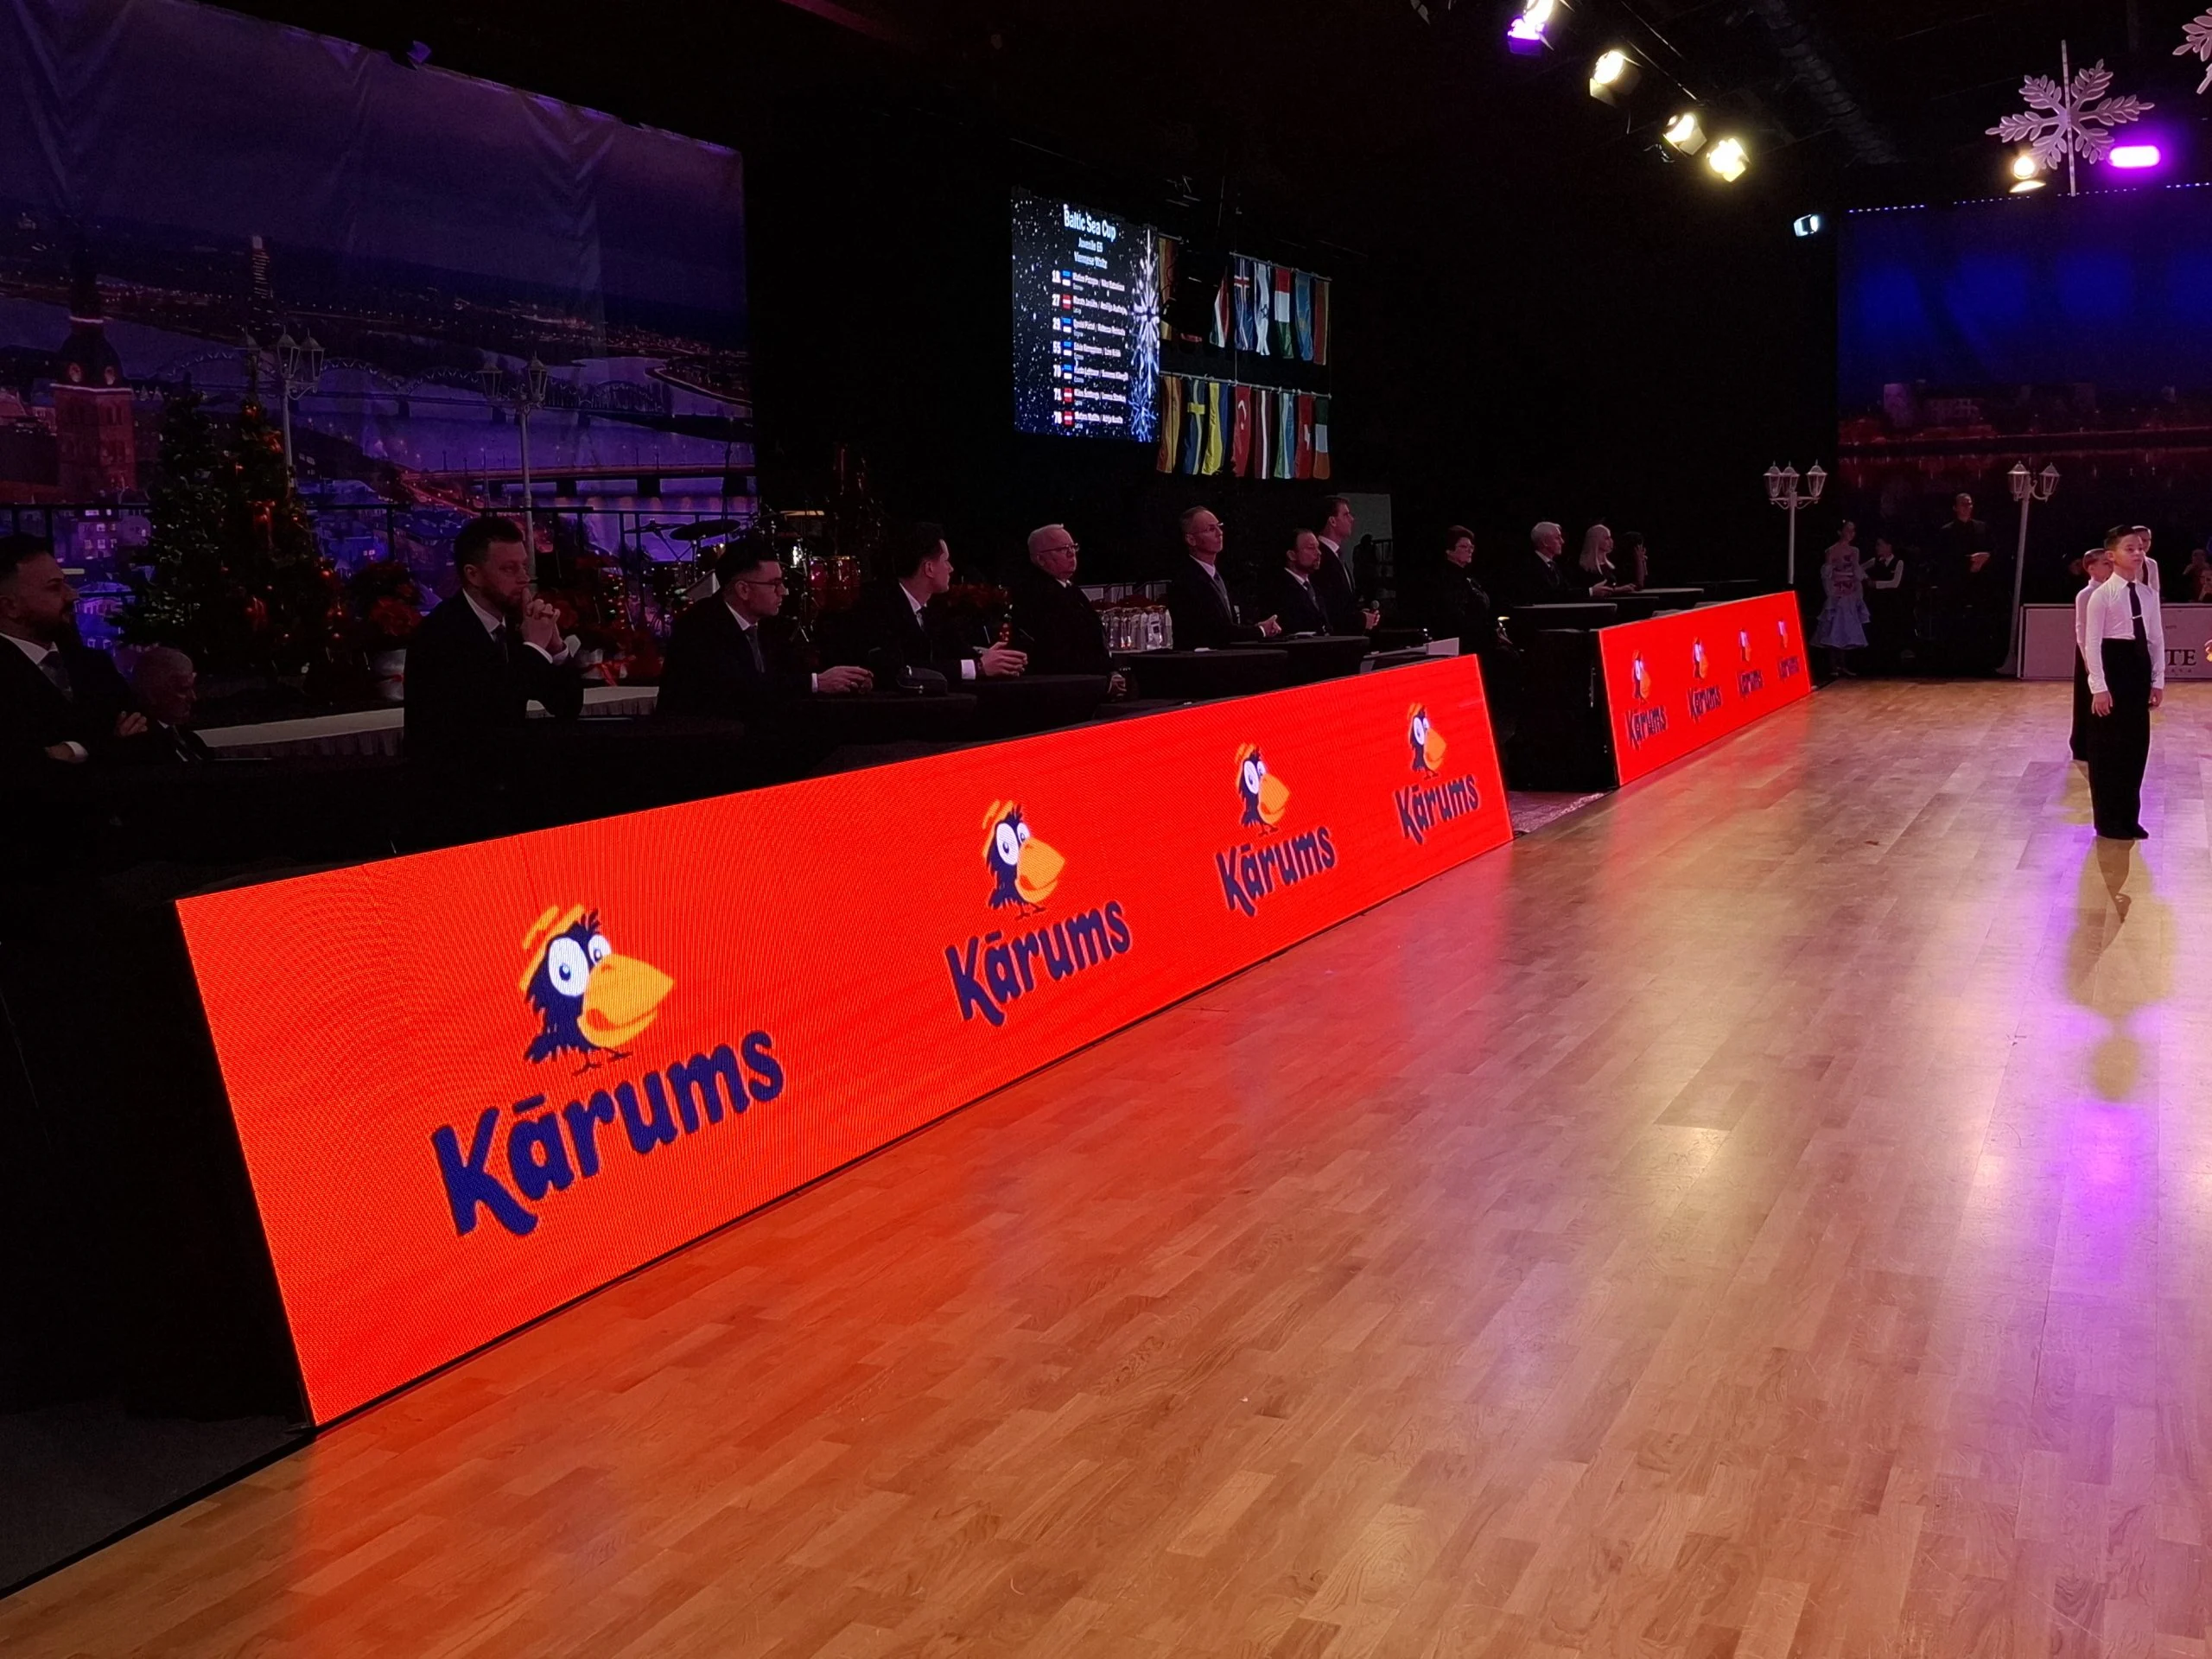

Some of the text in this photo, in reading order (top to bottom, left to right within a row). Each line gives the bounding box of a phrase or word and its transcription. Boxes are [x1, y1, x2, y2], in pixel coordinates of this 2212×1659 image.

[1064, 210, 1116, 242] Baltic Sea Cup
[1395, 774, 1479, 845] Kārums
[1215, 826, 1336, 917] Kārums
[944, 900, 1131, 1027] Kārums
[432, 1031, 784, 1236] Kārums
